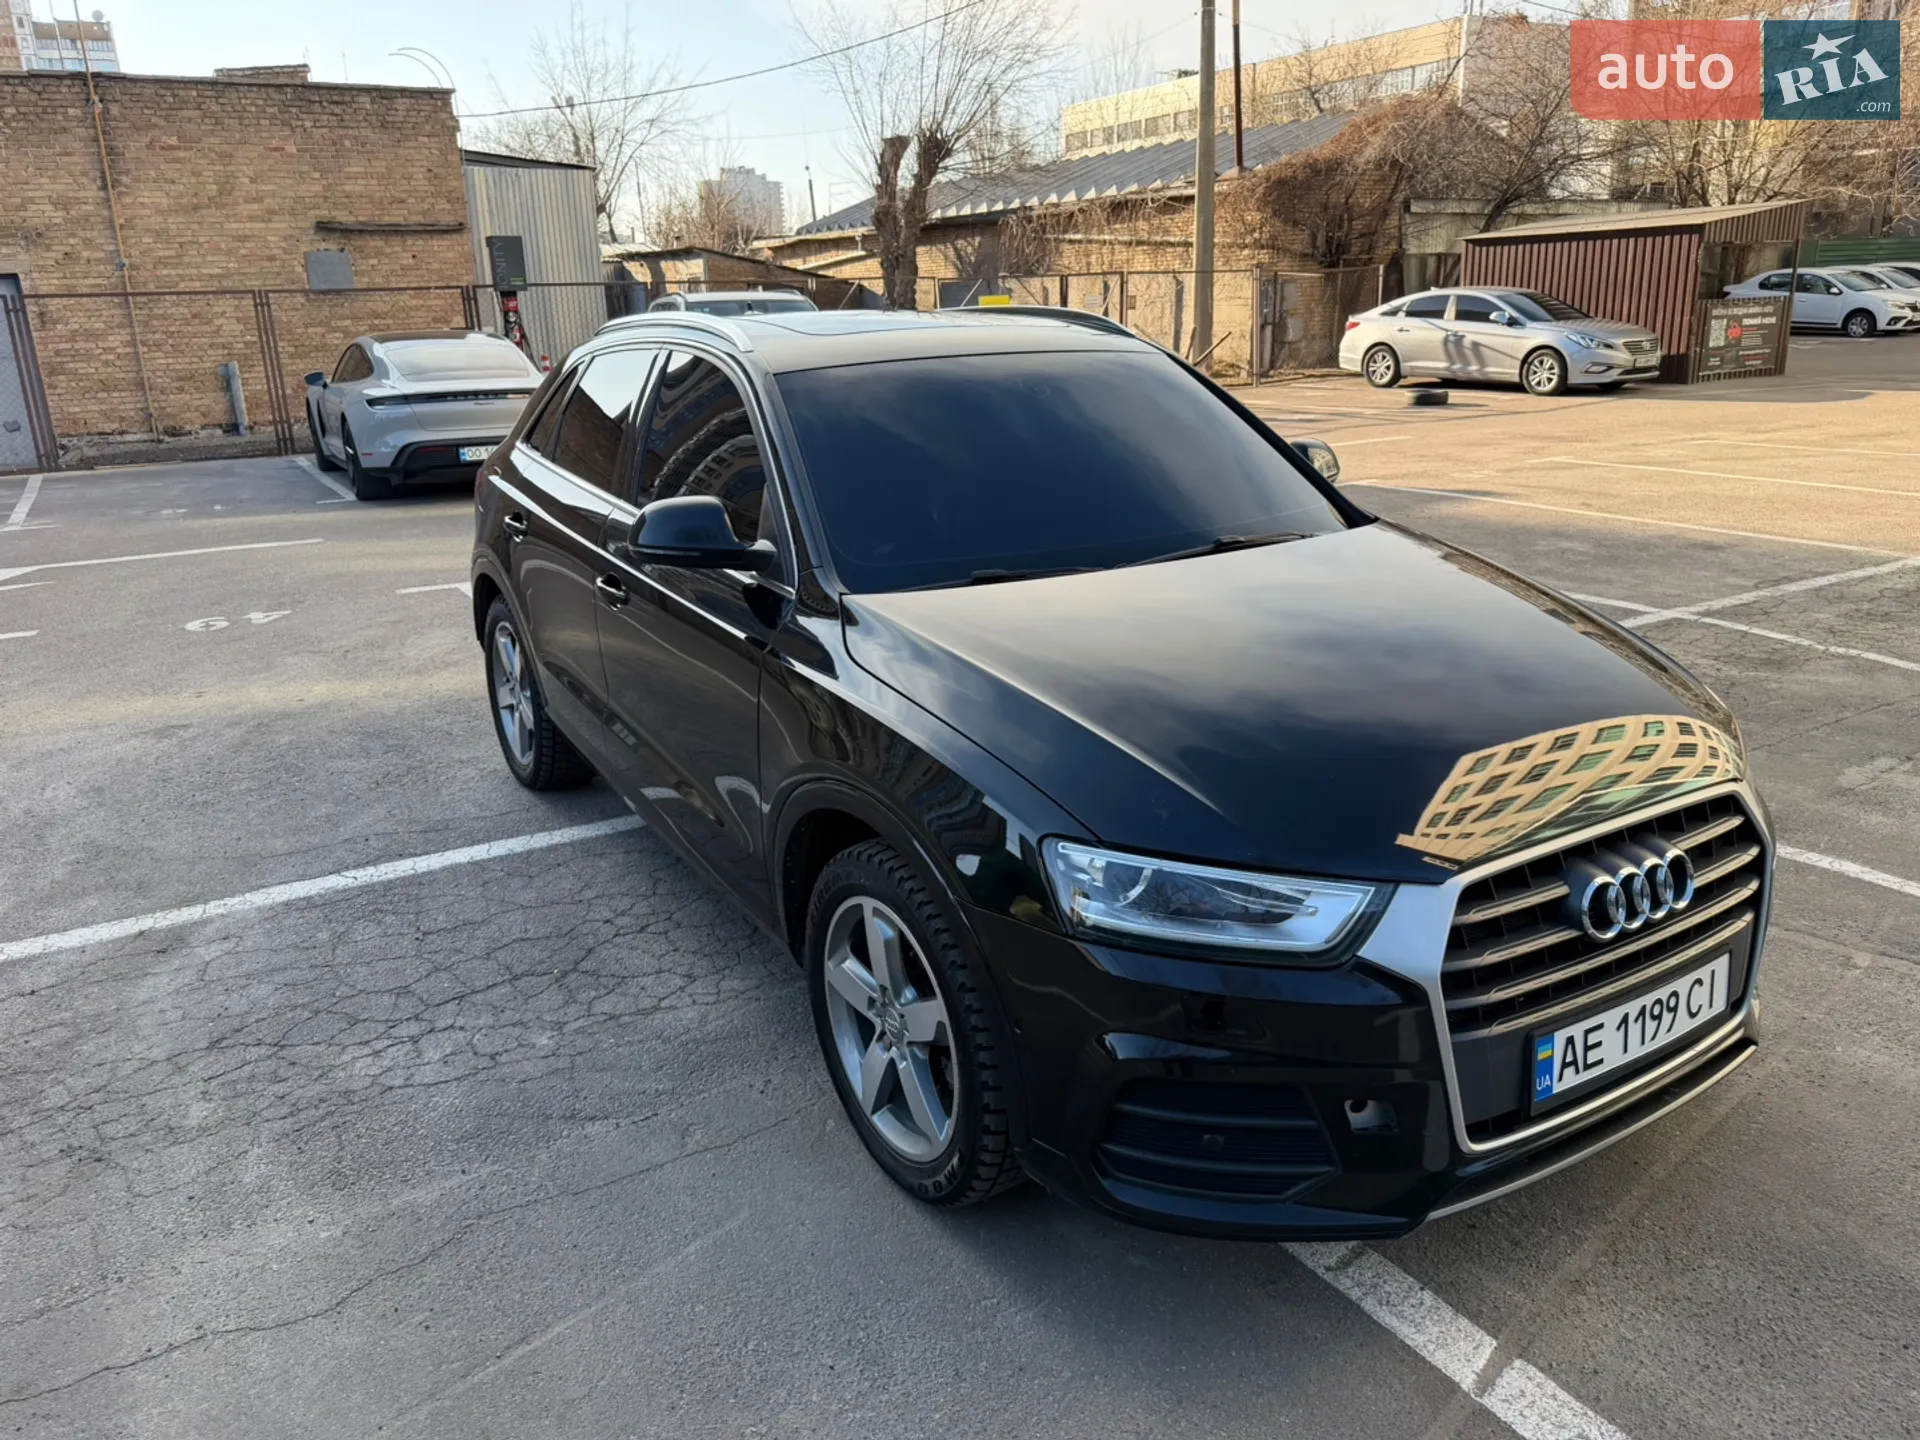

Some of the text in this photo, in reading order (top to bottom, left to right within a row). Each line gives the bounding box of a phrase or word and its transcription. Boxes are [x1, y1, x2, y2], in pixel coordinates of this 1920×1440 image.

[491, 237, 508, 289] IONITY
[1557, 969, 1716, 1083] AE 1199 CI
[1536, 1076, 1551, 1091] UA
